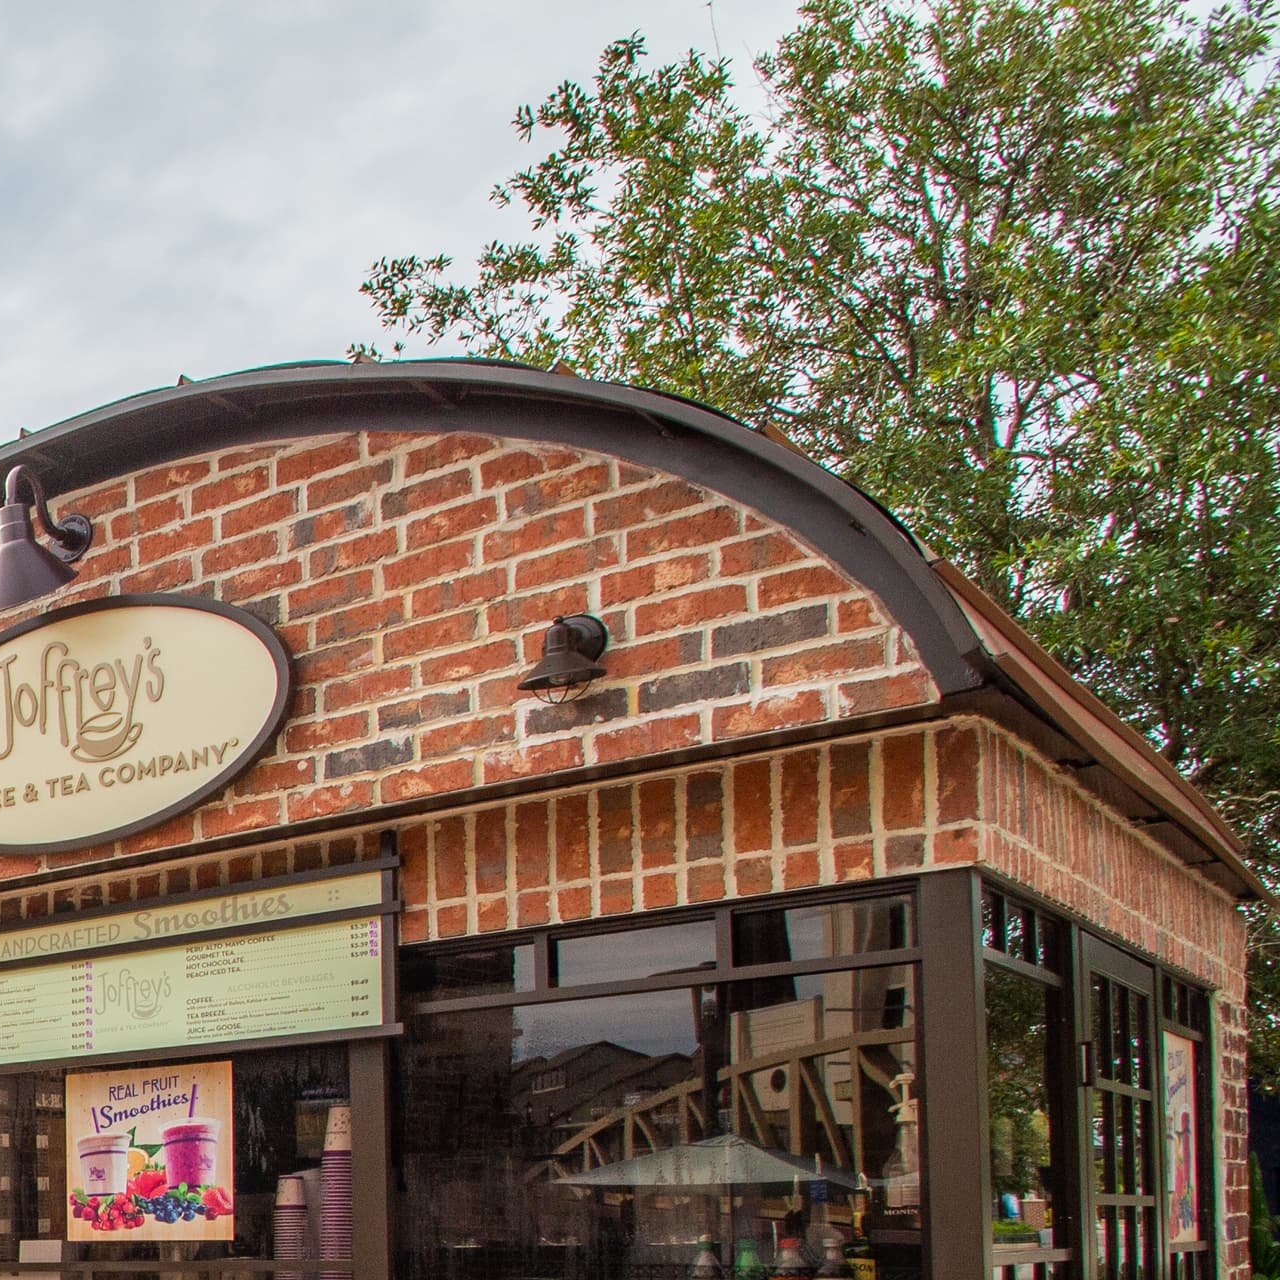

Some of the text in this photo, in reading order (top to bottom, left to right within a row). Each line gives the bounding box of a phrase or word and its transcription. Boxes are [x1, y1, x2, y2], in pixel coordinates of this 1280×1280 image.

[22, 782, 40, 803] &
[45, 771, 91, 800] TEA
[132, 892, 294, 941] Smoothies
[206, 943, 223, 951] ALTO
[225, 939, 246, 948] MAYO
[247, 935, 276, 945] COFFEE
[185, 951, 220, 962] GOURMET
[185, 962, 200, 970] HOT
[201, 957, 244, 968] CHOCOLATE
[185, 970, 209, 979] PEACH
[210, 968, 227, 976] ICED
[227, 972, 336, 993] ALCOHOLIC BEVERAGES
[95, 967, 172, 1016] Joffrey's
[186, 996, 212, 1006] COFFEE
[186, 1012, 200, 1020] TEA
[201, 1009, 225, 1018] BREEZE
[186, 1026, 206, 1035] JUICE
[216, 1022, 241, 1031] GOOSE
[108, 1075, 180, 1102] REAL FRUIT
[99, 1091, 190, 1129] Smoothies
